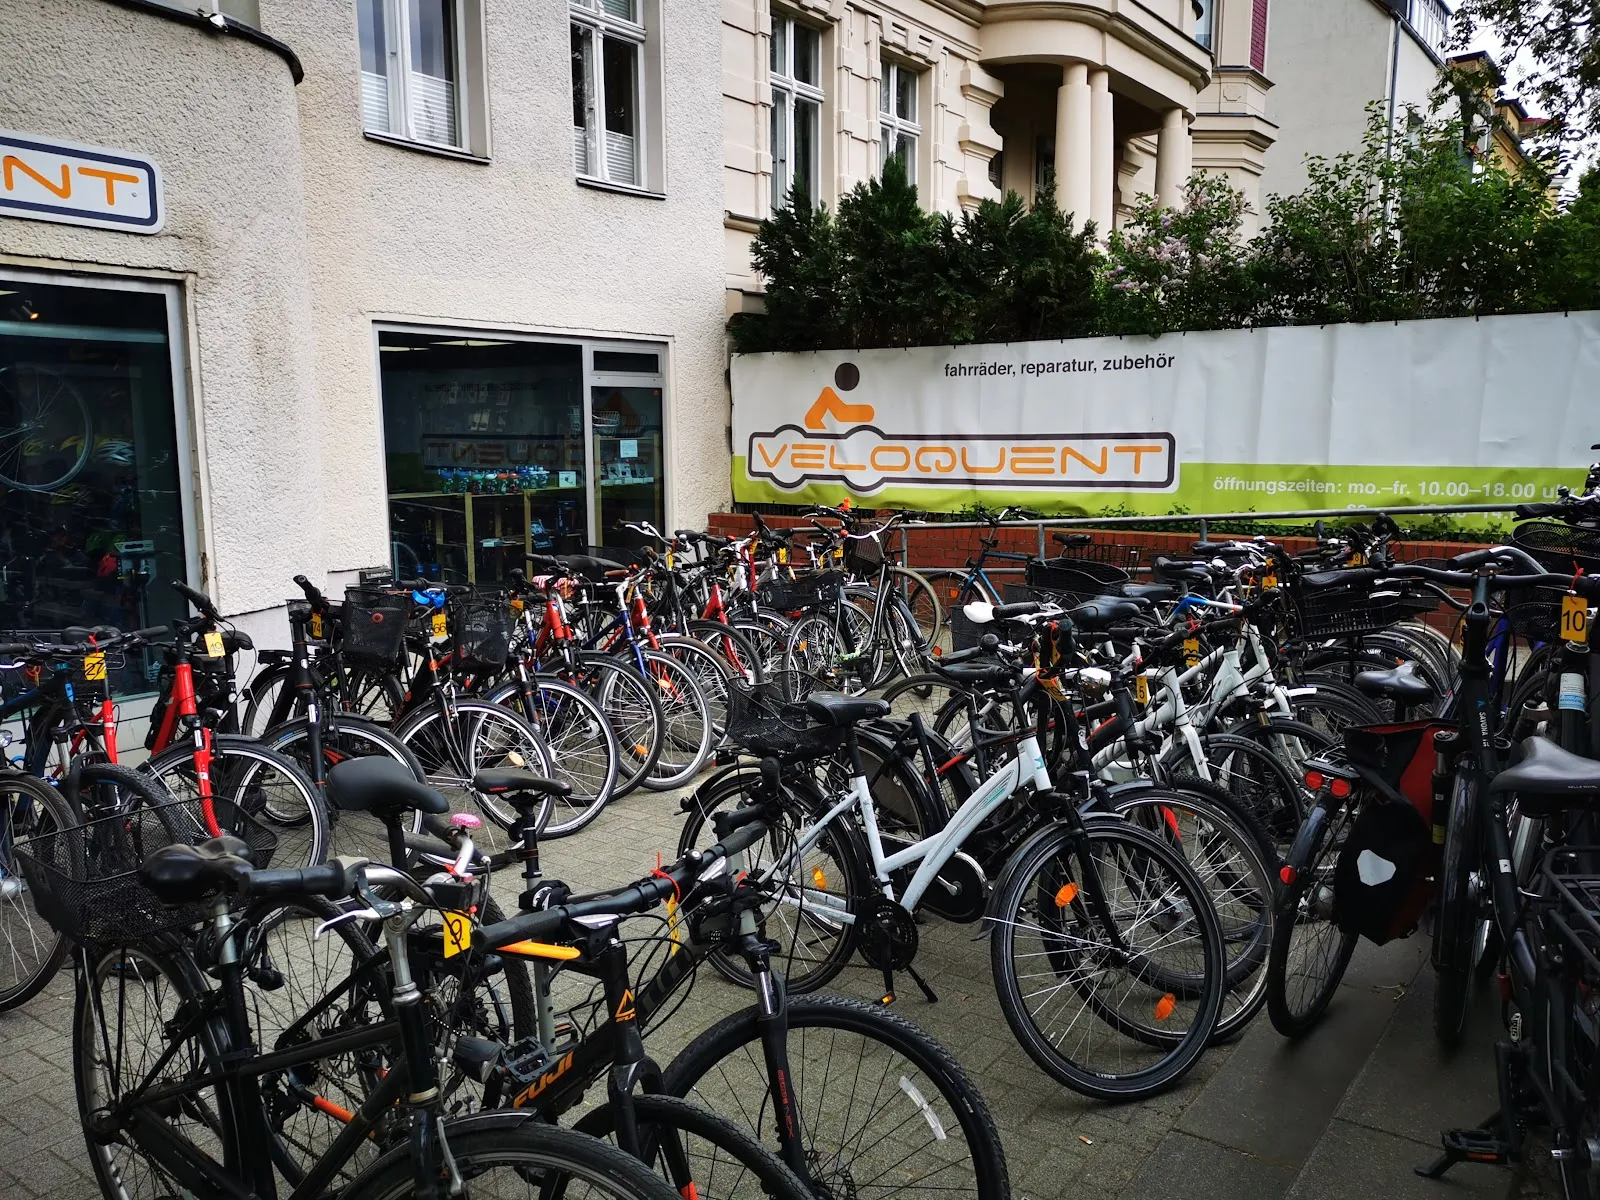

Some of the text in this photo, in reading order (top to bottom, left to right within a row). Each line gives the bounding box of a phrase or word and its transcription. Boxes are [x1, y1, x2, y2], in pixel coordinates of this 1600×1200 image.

[944, 353, 1176, 378] fahrräder, reparatur, zubehör
[757, 442, 1163, 475] VELOQUENT
[1213, 476, 1343, 495] öffnungszeiten:
[433, 623, 446, 634] 66
[1563, 610, 1586, 632] 10
[1138, 687, 1145, 699] 5
[513, 1048, 575, 1110] FUJI
